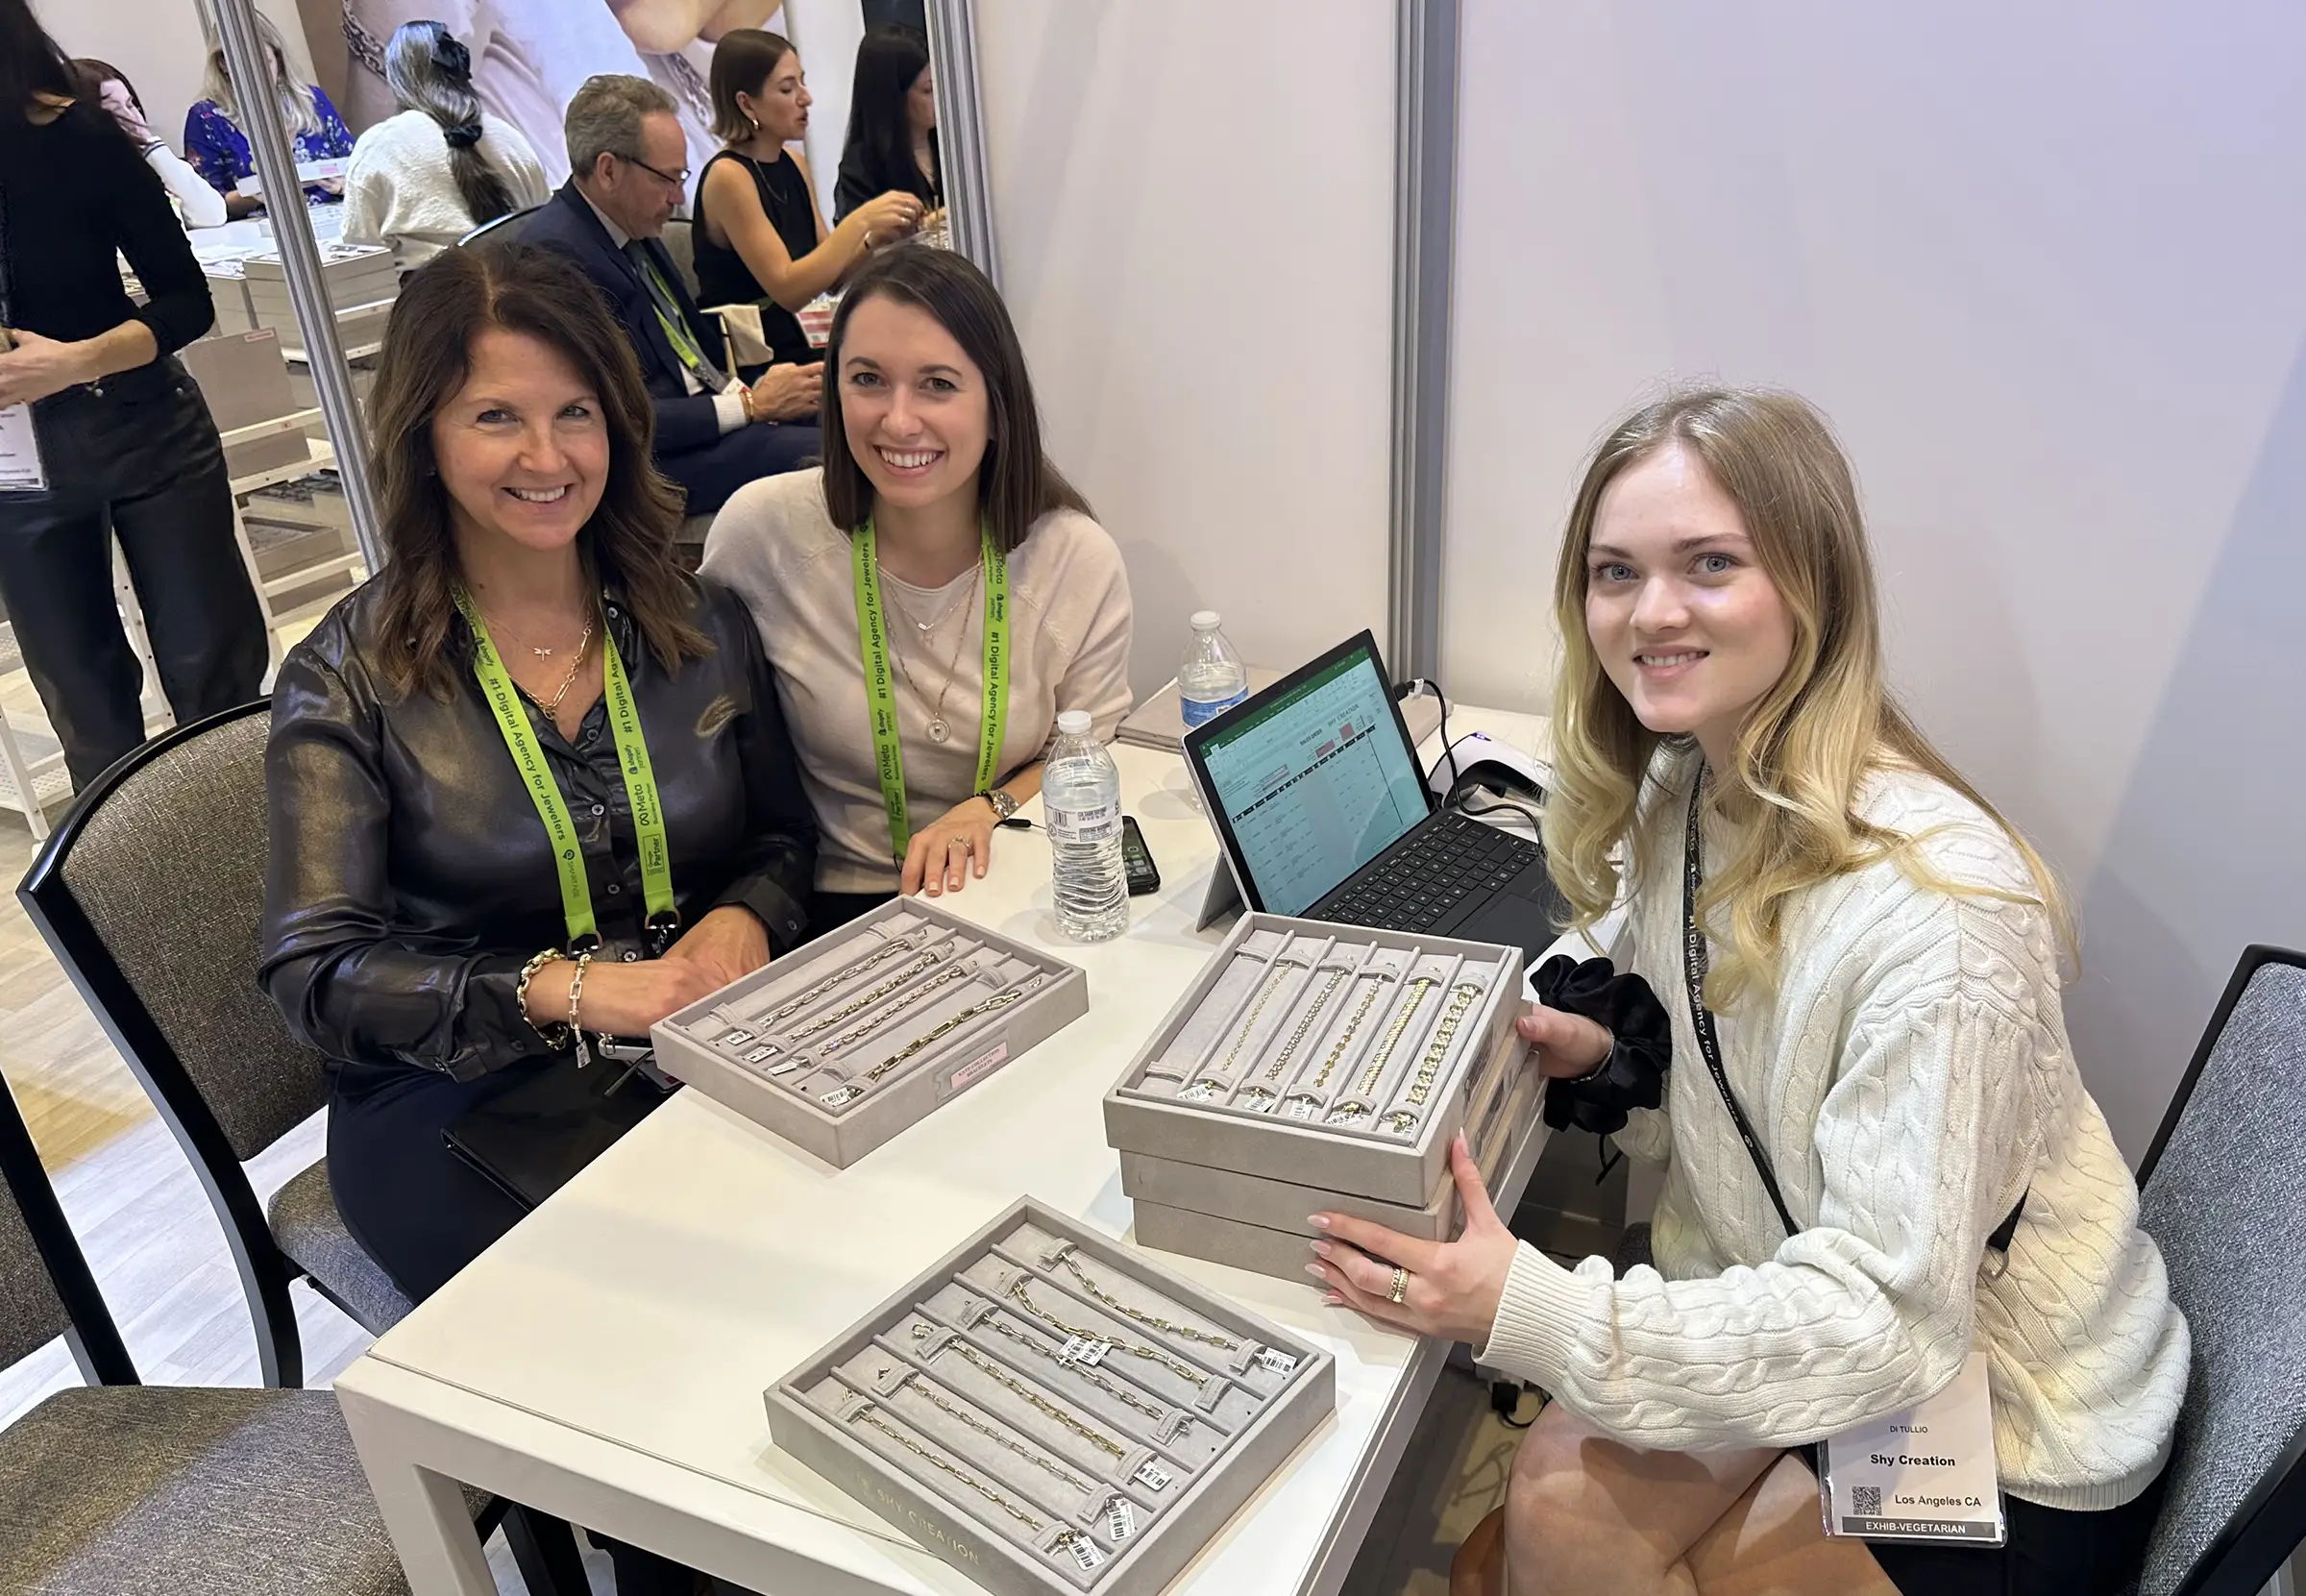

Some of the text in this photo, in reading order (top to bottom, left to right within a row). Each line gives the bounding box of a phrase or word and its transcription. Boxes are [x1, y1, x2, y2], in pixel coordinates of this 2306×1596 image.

[861, 541, 887, 700] #1 Digital Agency for Jewelers
[612, 681, 630, 719] Digital
[980, 631, 1000, 781] #1 Digital Agency for Jewelers
[623, 721, 633, 733] #1
[488, 677, 566, 841] #1 Digital Agency for Jewelers
[879, 744, 892, 768] Meta
[633, 783, 647, 813] Meta
[652, 838, 662, 866] Partner
[1687, 915, 1740, 1123] #1 Digital Agency for Jewelers
[1889, 1425, 1928, 1434] DI TULLIO
[1870, 1454, 1956, 1467] Shy Creation
[1895, 1494, 1982, 1508] Los Angeles CA
[876, 1488, 981, 1567] SHY CREATION
[1865, 1521, 1966, 1535] EXHIB-VEGETARIAN
